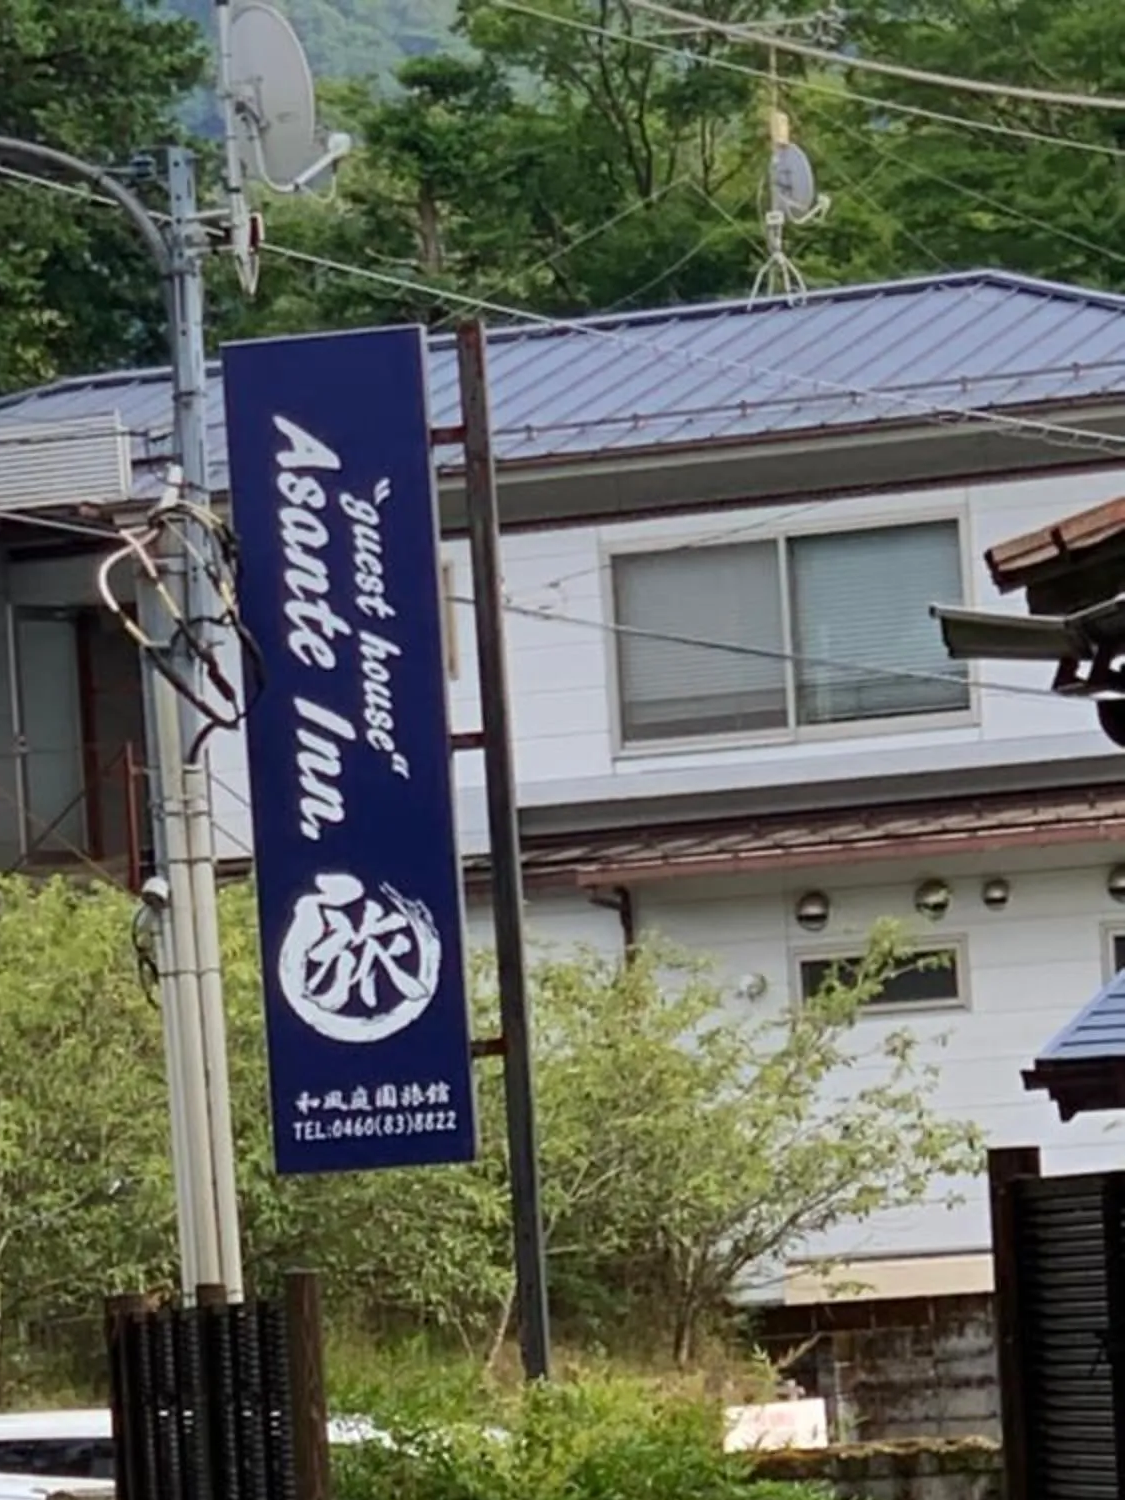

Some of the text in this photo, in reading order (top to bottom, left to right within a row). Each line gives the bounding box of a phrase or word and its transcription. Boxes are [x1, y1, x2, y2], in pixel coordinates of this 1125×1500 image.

[272, 414, 357, 842] Asante Inn
[287, 873, 435, 1022] 旅
[293, 1110, 457, 1141] TEL:0460(83)8822
